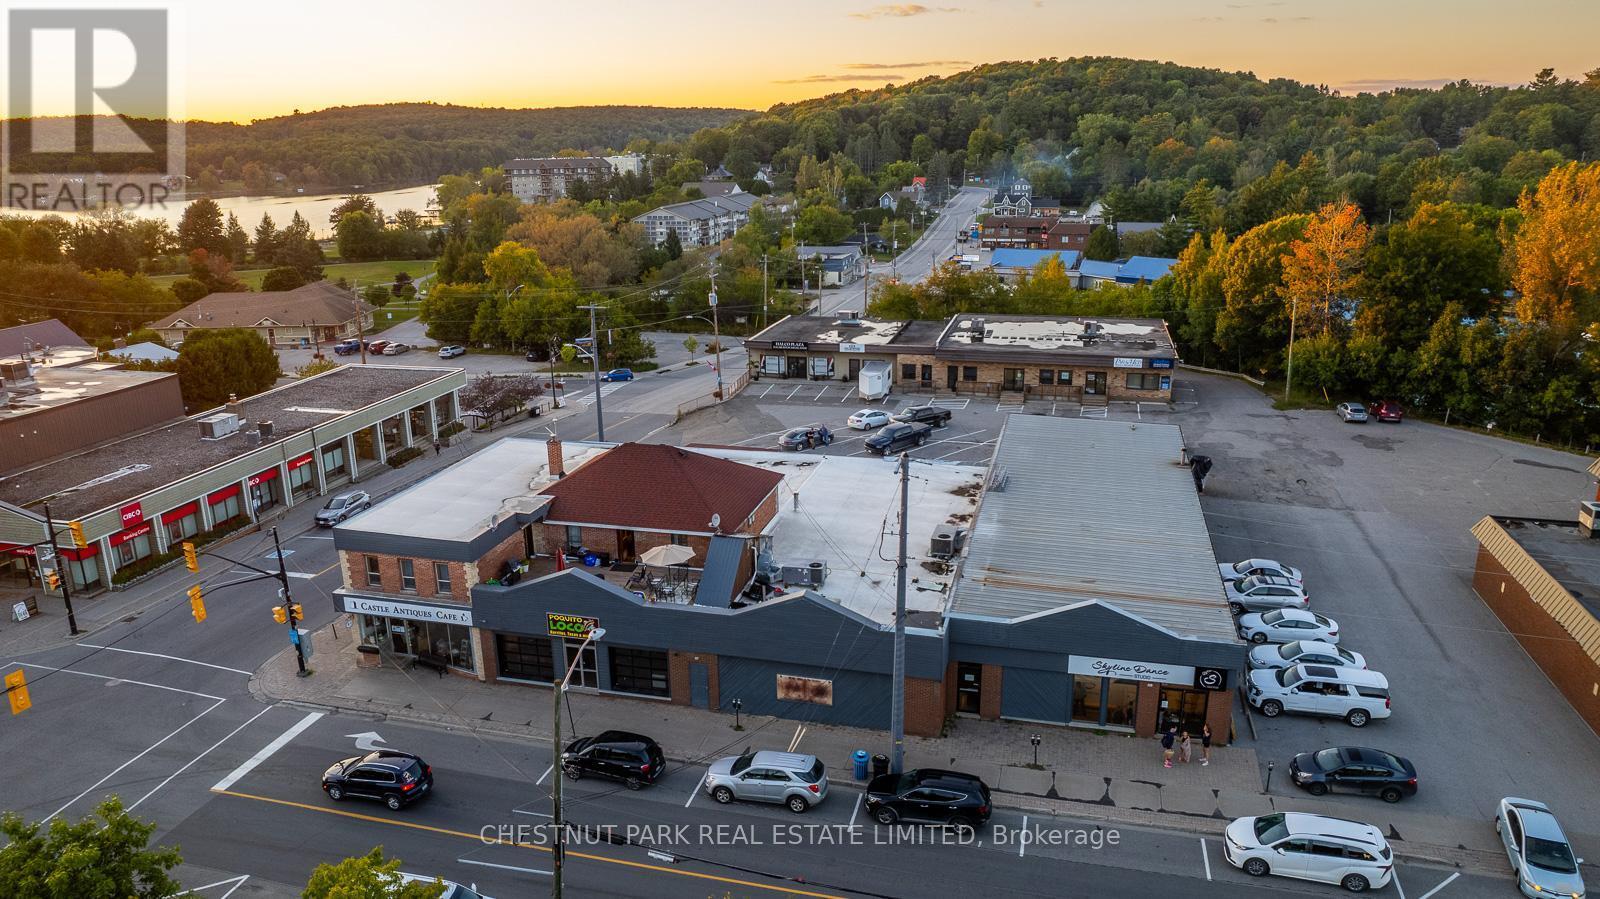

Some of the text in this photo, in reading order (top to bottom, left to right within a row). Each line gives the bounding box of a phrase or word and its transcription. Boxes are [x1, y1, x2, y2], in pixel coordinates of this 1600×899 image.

[550, 621, 585, 632] LOCO
[1092, 661, 1169, 675] Skyline Dance
